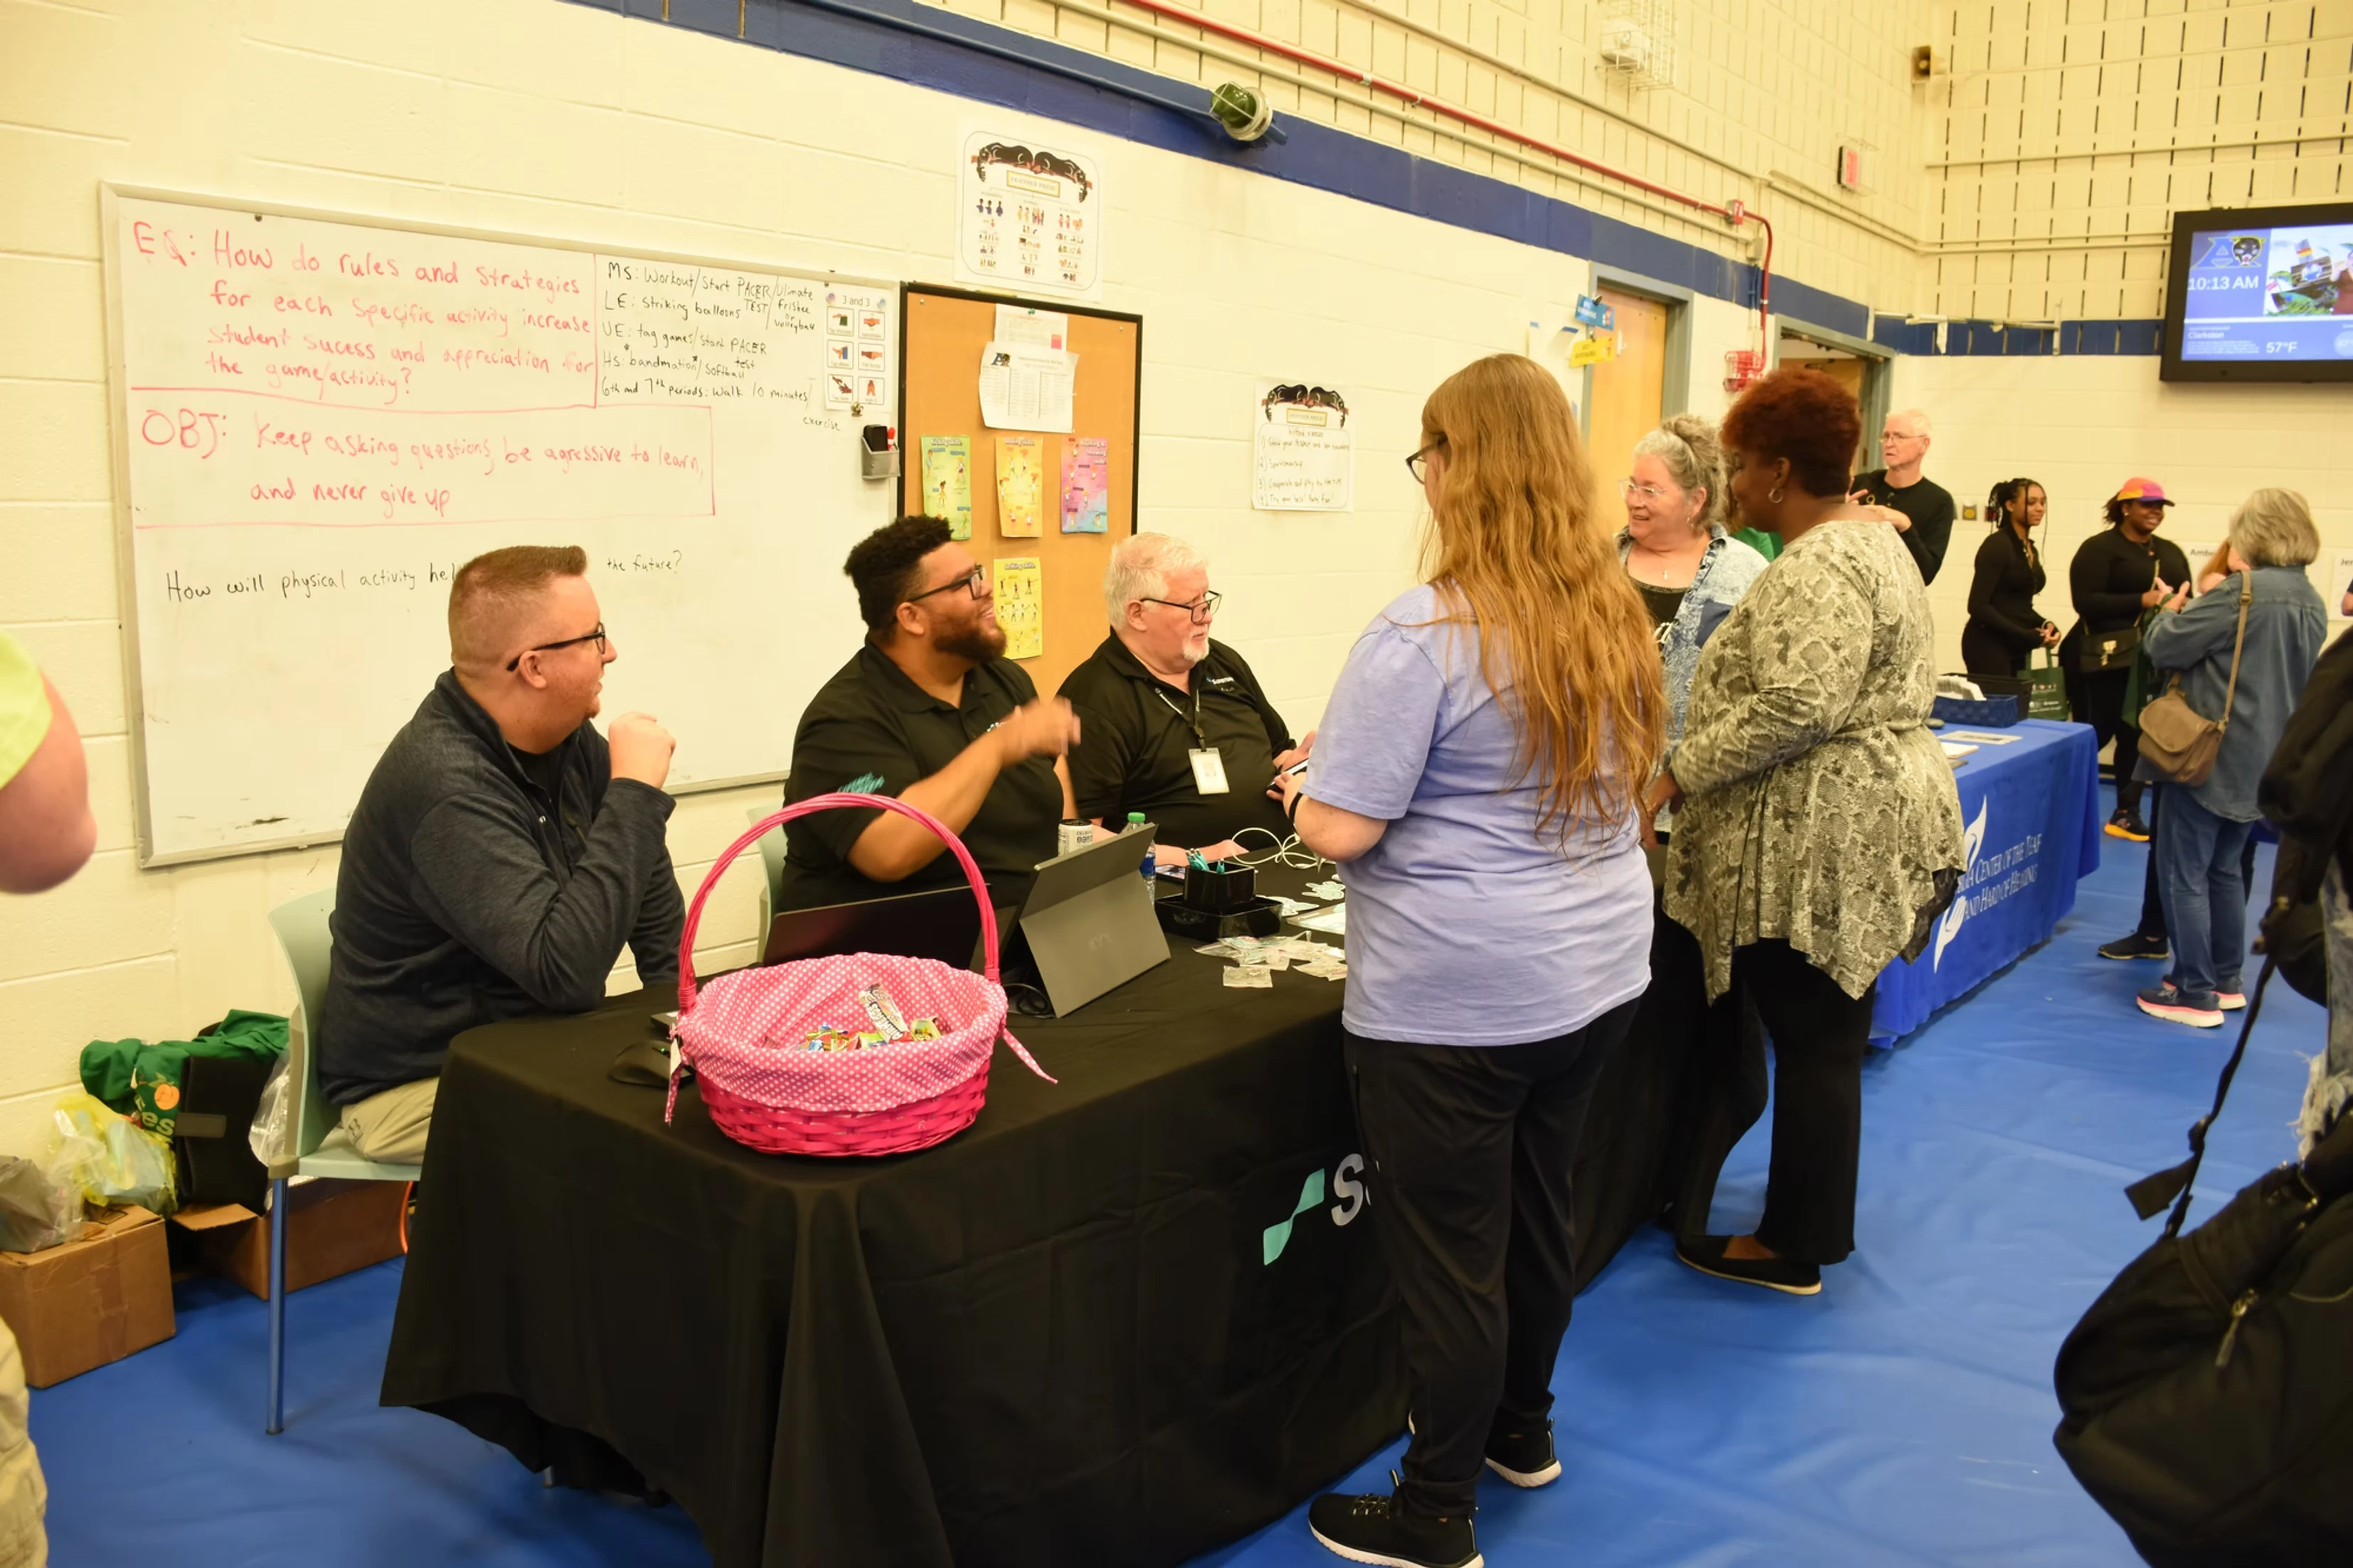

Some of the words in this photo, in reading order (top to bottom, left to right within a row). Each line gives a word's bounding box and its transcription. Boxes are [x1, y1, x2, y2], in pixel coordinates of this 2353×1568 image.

[214, 229, 272, 269] How
[292, 242, 319, 271] do
[339, 252, 399, 277] rules
[415, 261, 459, 284] and
[608, 261, 639, 280] MS:
[2188, 276, 2230, 291] 10:13
[2232, 275, 2259, 290] AM
[211, 279, 250, 307] for
[274, 295, 332, 316] each
[447, 306, 508, 338] activity
[523, 308, 591, 334] increase
[605, 290, 635, 311] LE:
[695, 302, 741, 319] balloons
[743, 298, 769, 314] TEST
[843, 295, 847, 305] 3
[849, 297, 864, 307] and
[866, 298, 870, 307] 3
[602, 321, 631, 338] UE:
[638, 324, 659, 348] tag
[730, 336, 766, 356] PACER
[2266, 340, 2298, 354] 57°F
[206, 351, 243, 375] the
[391, 341, 425, 363] and
[443, 348, 550, 373] appreciation
[562, 351, 593, 373] for
[735, 356, 755, 369] test
[602, 376, 620, 396] 6th
[625, 382, 638, 393] and
[644, 378, 665, 394] 7th
[669, 385, 708, 398] periods:
[753, 382, 764, 397] 10
[803, 417, 841, 432] exercise
[142, 408, 227, 459] OBJ:
[325, 434, 399, 466] asking
[503, 436, 532, 464] be
[544, 445, 622, 474] agressive
[631, 443, 649, 462] to
[250, 477, 297, 500] and
[313, 484, 367, 501] never
[381, 484, 417, 519] give
[425, 489, 450, 517] up
[607, 557, 626, 572] the
[632, 549, 683, 574] future?
[166, 570, 211, 602] How
[226, 575, 265, 593] will
[282, 570, 346, 599] physical
[360, 570, 415, 590] activity
[429, 562, 455, 583] hel
[1964, 895, 1981, 922] AND
[1331, 1153, 1366, 1226] S
